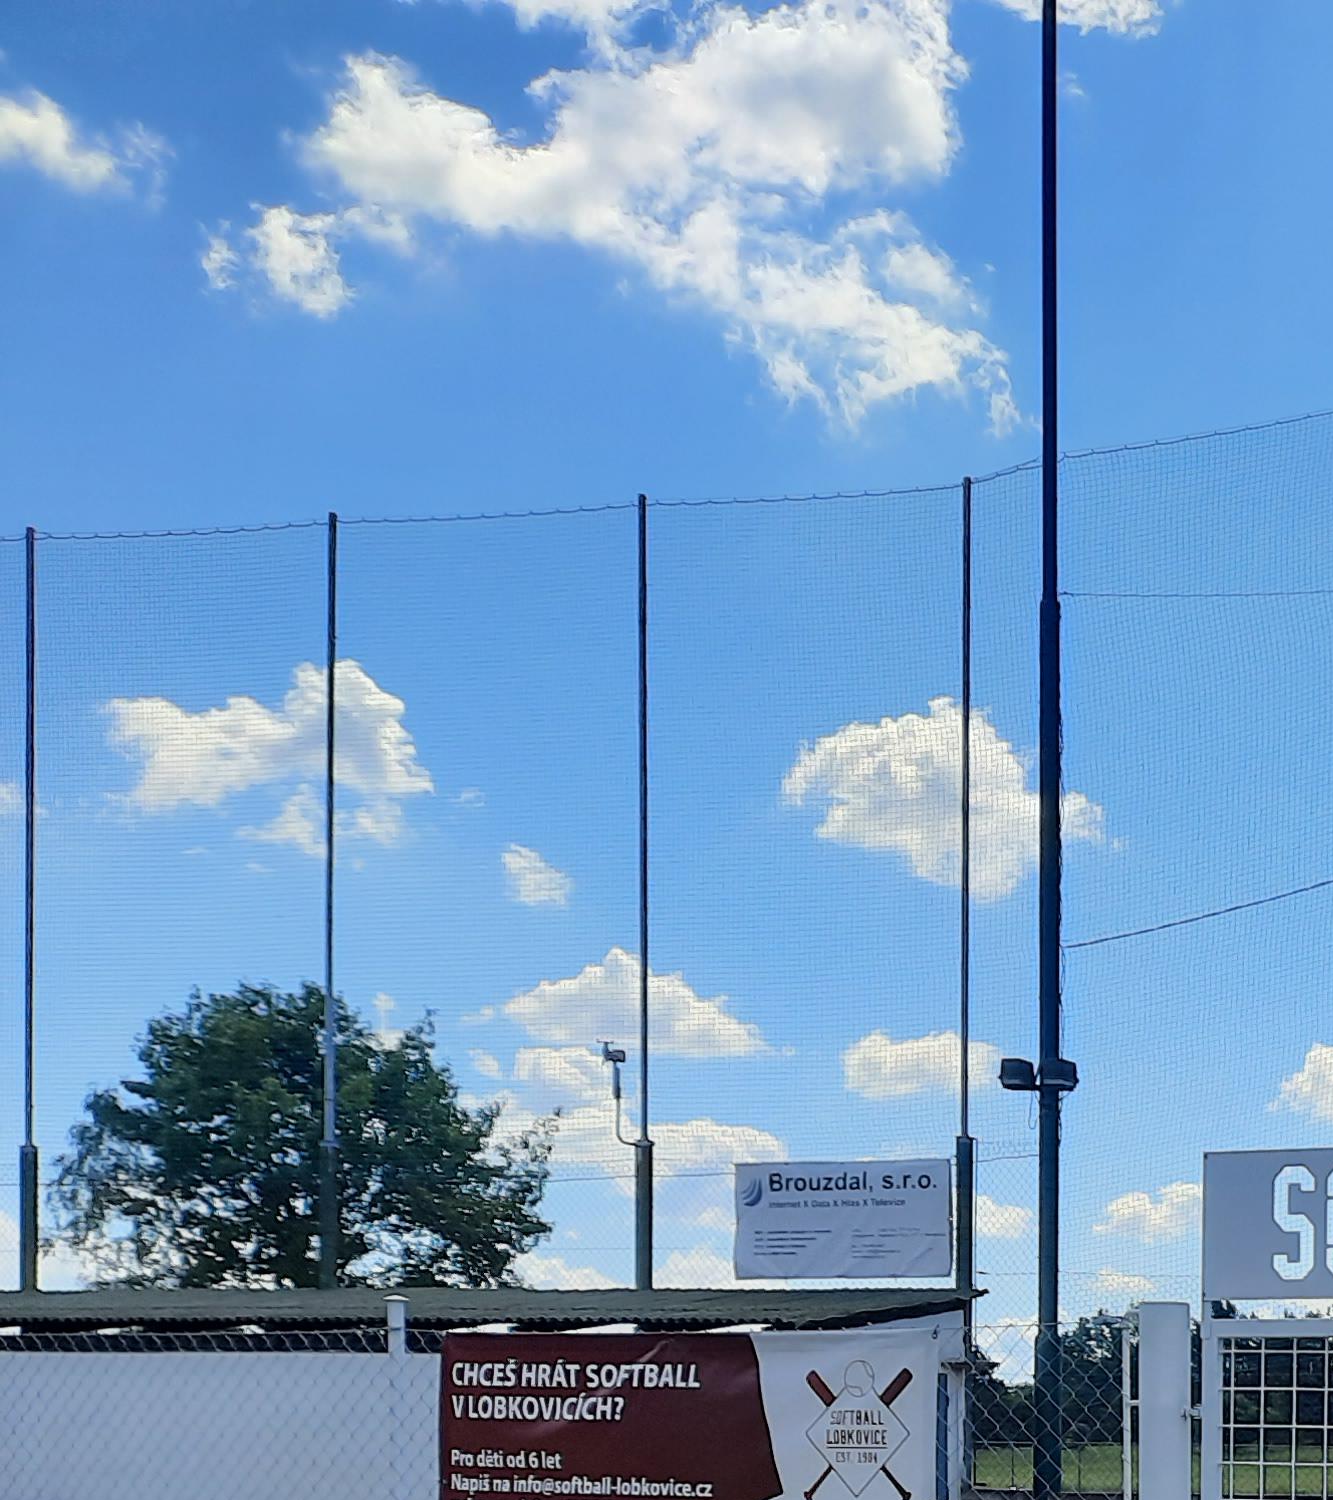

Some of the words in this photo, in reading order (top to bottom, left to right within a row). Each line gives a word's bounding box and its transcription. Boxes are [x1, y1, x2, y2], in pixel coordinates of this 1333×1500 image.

[769, 1171, 873, 1192] Brouzdal,
[882, 1173, 937, 1189] s.r.o.
[452, 1358, 517, 1386] CHCEŠ
[521, 1359, 581, 1388] HRÁT
[586, 1364, 700, 1388] SOFTBALL
[451, 1395, 464, 1418] V
[468, 1393, 625, 1420] LOBKOVICÍCH?
[830, 1409, 884, 1425] SOFTBALL
[826, 1429, 888, 1445] LOBKOVICE
[451, 1450, 473, 1467] Pro
[476, 1450, 504, 1467] děti
[506, 1451, 525, 1468] od
[528, 1452, 538, 1468] 6
[541, 1451, 562, 1469] let
[451, 1474, 490, 1495] Napiš
[493, 1479, 510, 1492] na
[513, 1475, 713, 1497] info@softball-lobkovice.cz
